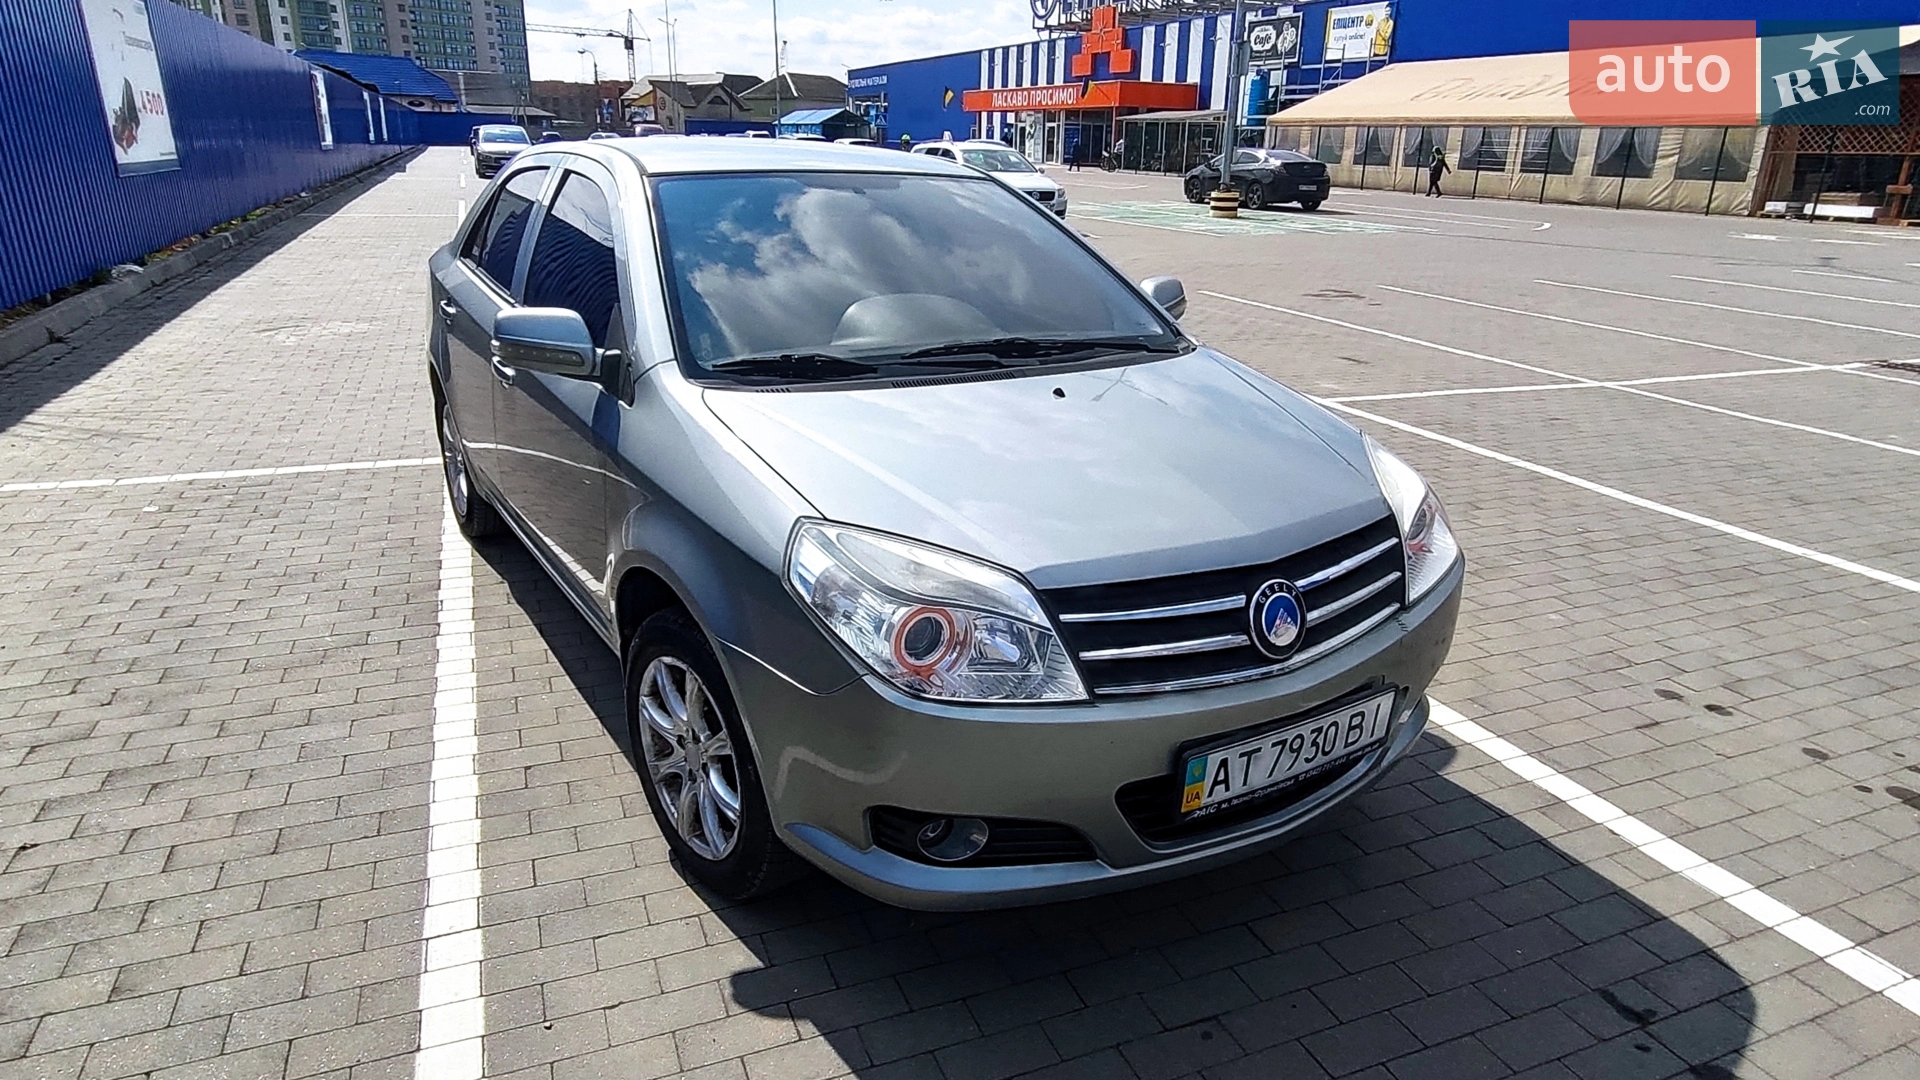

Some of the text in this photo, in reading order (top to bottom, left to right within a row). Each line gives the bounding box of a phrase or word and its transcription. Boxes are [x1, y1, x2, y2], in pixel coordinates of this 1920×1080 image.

[1332, 15, 1364, 30] ЕПІЦЕНТР
[992, 87, 1077, 108] ЛАСКАВО ПРОСИМО!
[1258, 583, 1297, 604] GEELY
[1266, 720, 1340, 779] 7930
[1185, 791, 1201, 804] UA
